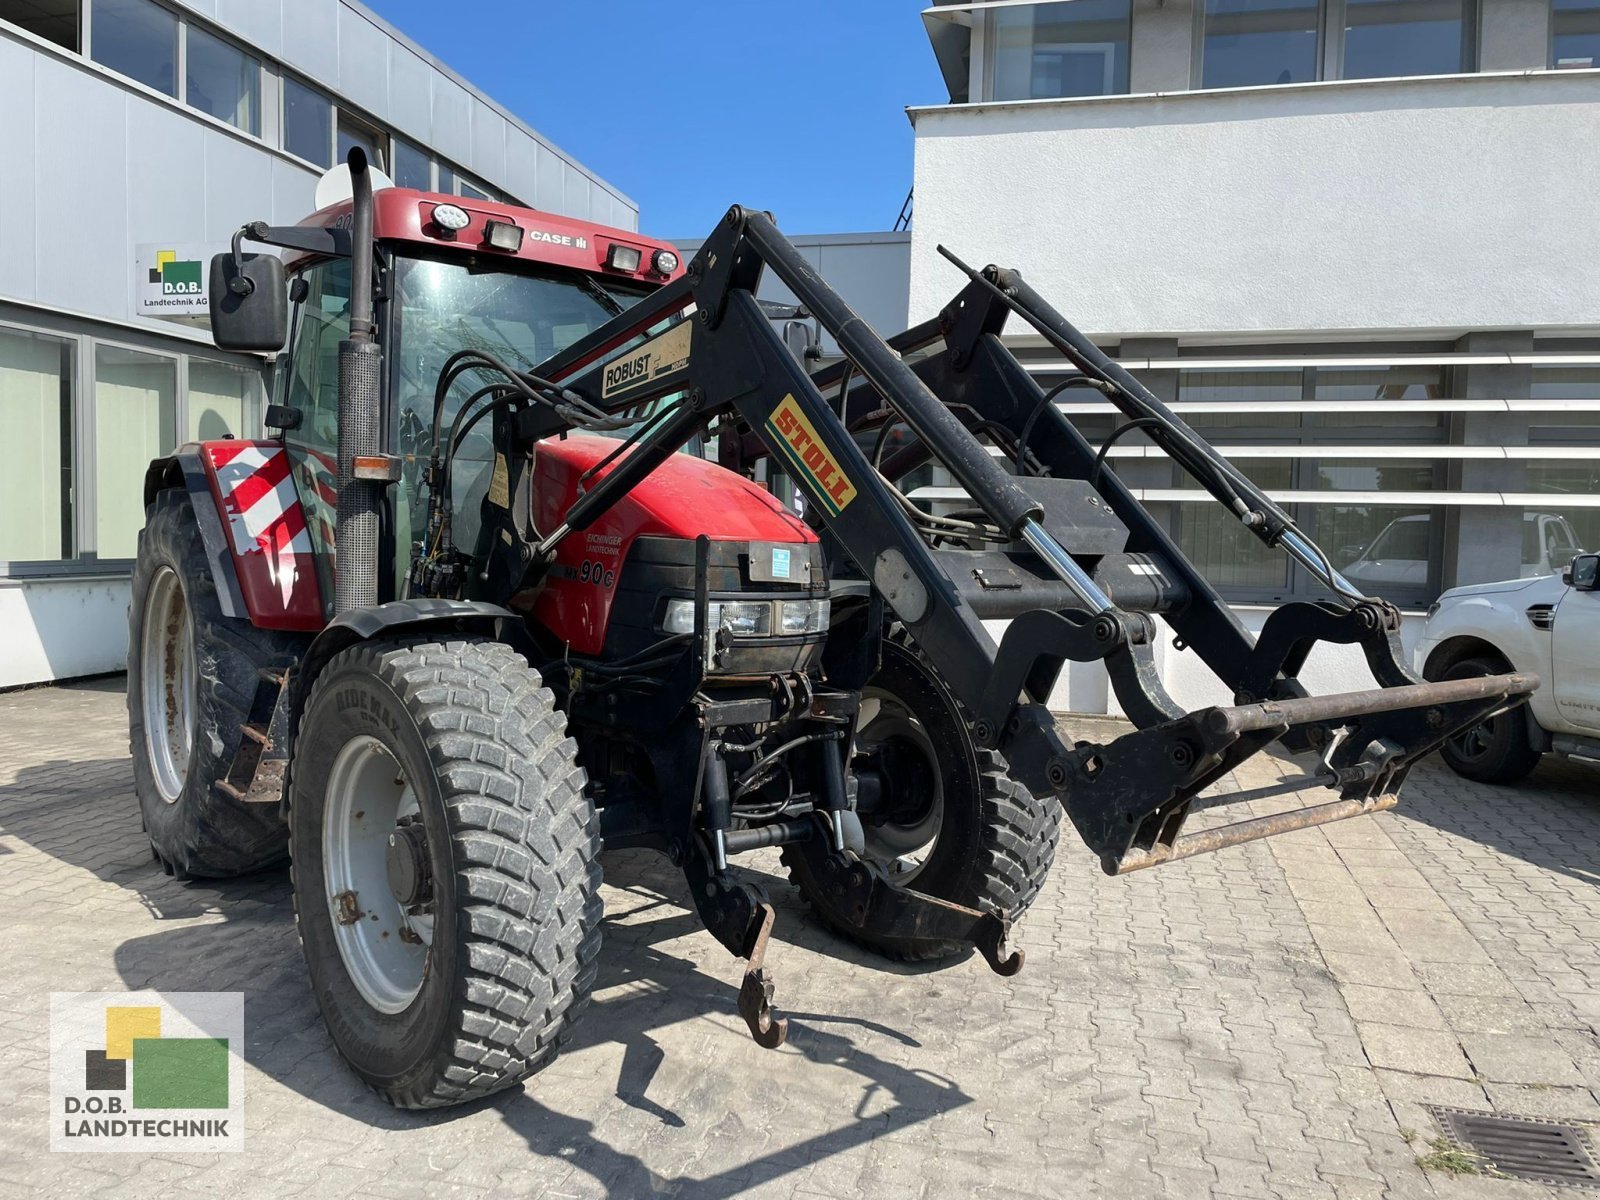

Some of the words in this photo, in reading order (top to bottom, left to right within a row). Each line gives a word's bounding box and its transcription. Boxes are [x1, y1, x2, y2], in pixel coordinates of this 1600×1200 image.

[530, 230, 571, 246] CASE
[164, 282, 202, 294] D.O.B.
[144, 298, 194, 307] Landtechnik
[195, 298, 208, 306] AG
[606, 352, 652, 387] ROBUST
[775, 407, 850, 507] STOLL
